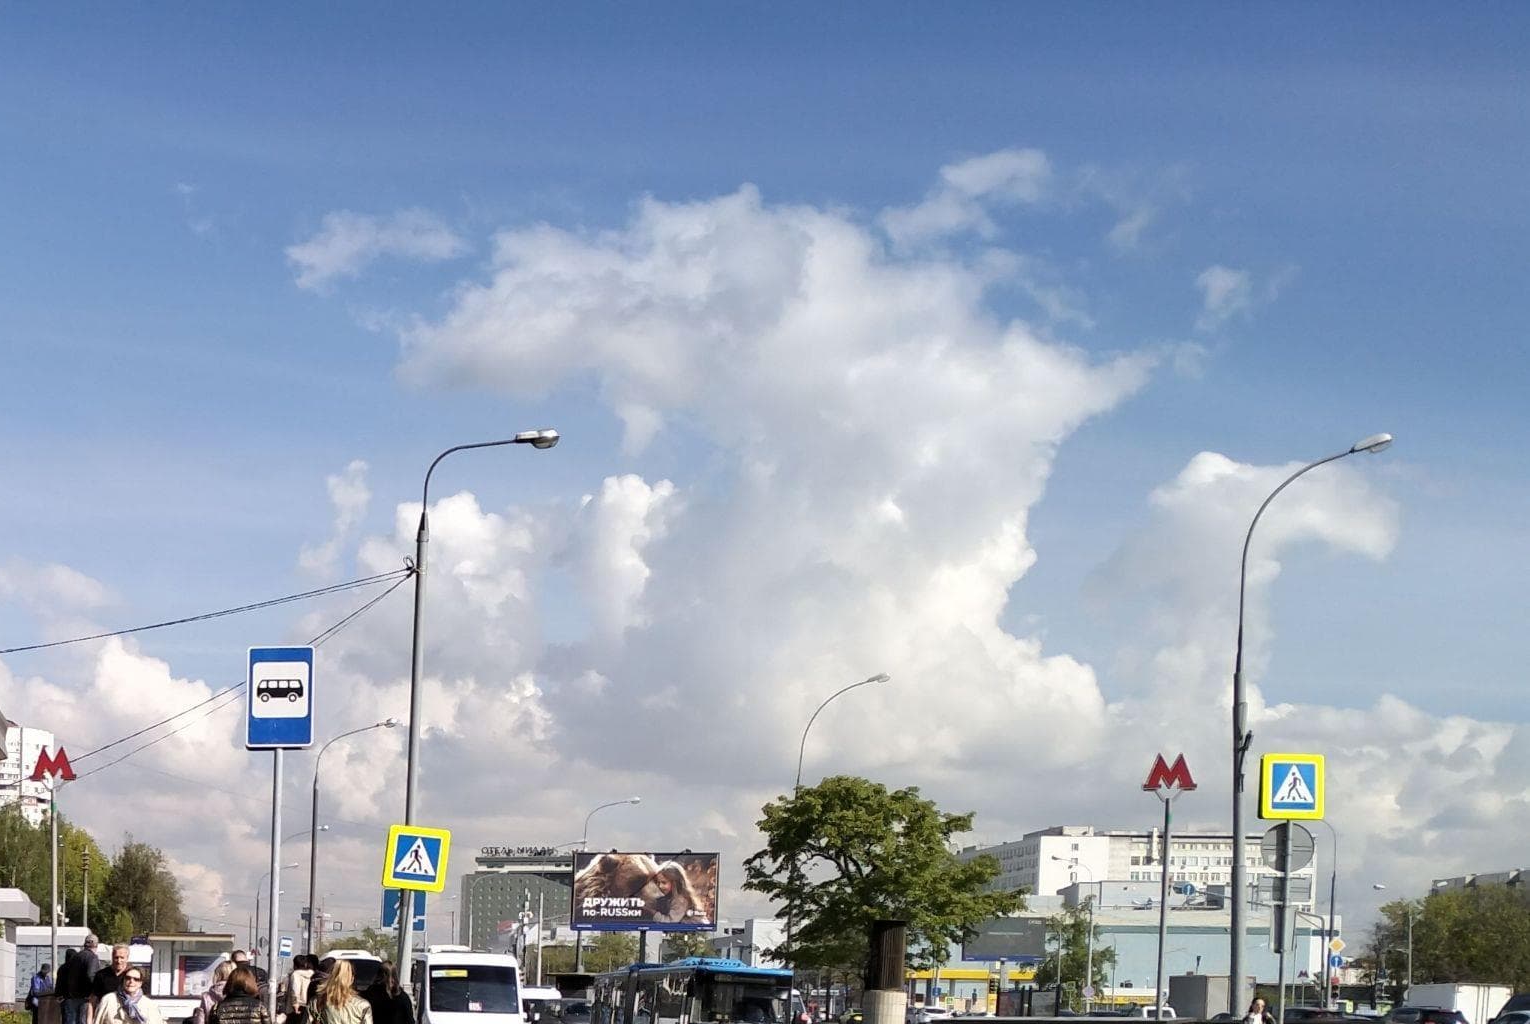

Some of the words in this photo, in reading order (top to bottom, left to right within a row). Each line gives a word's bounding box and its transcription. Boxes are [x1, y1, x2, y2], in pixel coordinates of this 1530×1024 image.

[481, 846, 514, 857] ОТЕЛЬ
[582, 897, 646, 908] ДРУЖИТЬ
[582, 907, 642, 917] по-RUSSки
